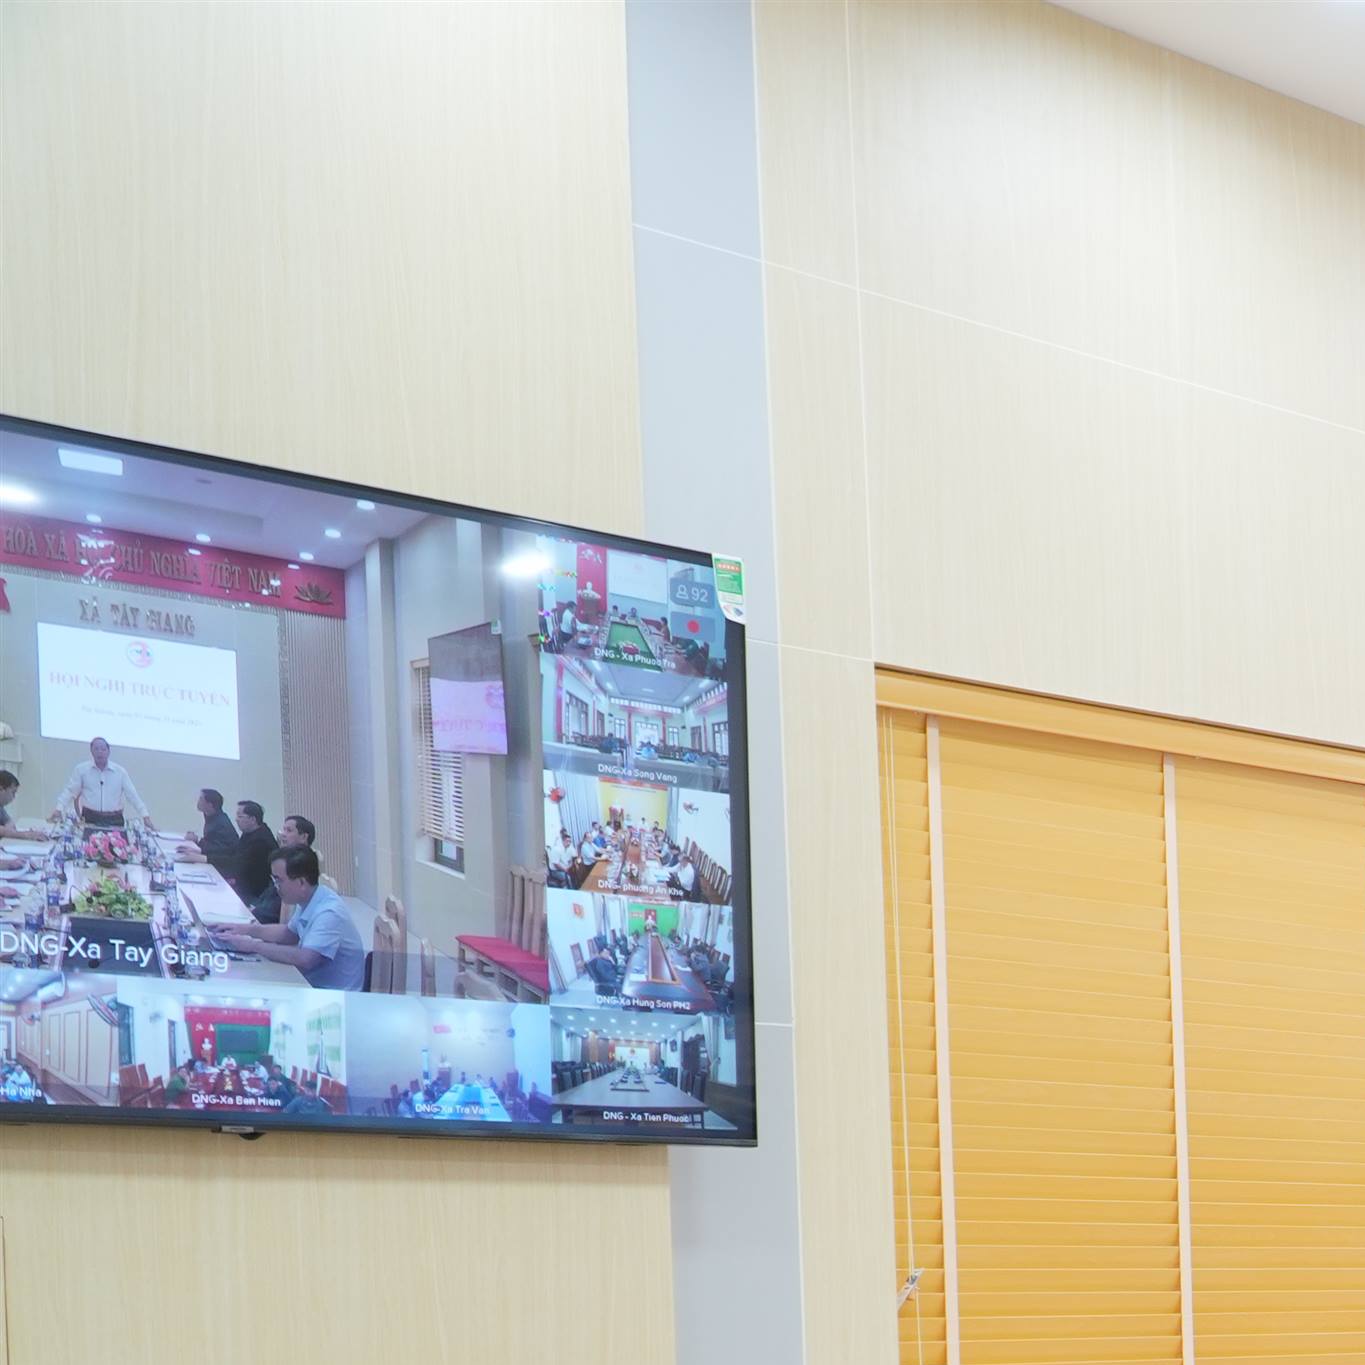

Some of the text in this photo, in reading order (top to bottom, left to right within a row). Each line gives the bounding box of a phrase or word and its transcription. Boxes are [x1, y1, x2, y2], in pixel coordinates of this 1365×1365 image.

[690, 588, 709, 603] 92
[633, 769, 655, 781] Song
[108, 938, 153, 968] Tay
[161, 943, 229, 973] Giang
[602, 1111, 625, 1121] DNG
